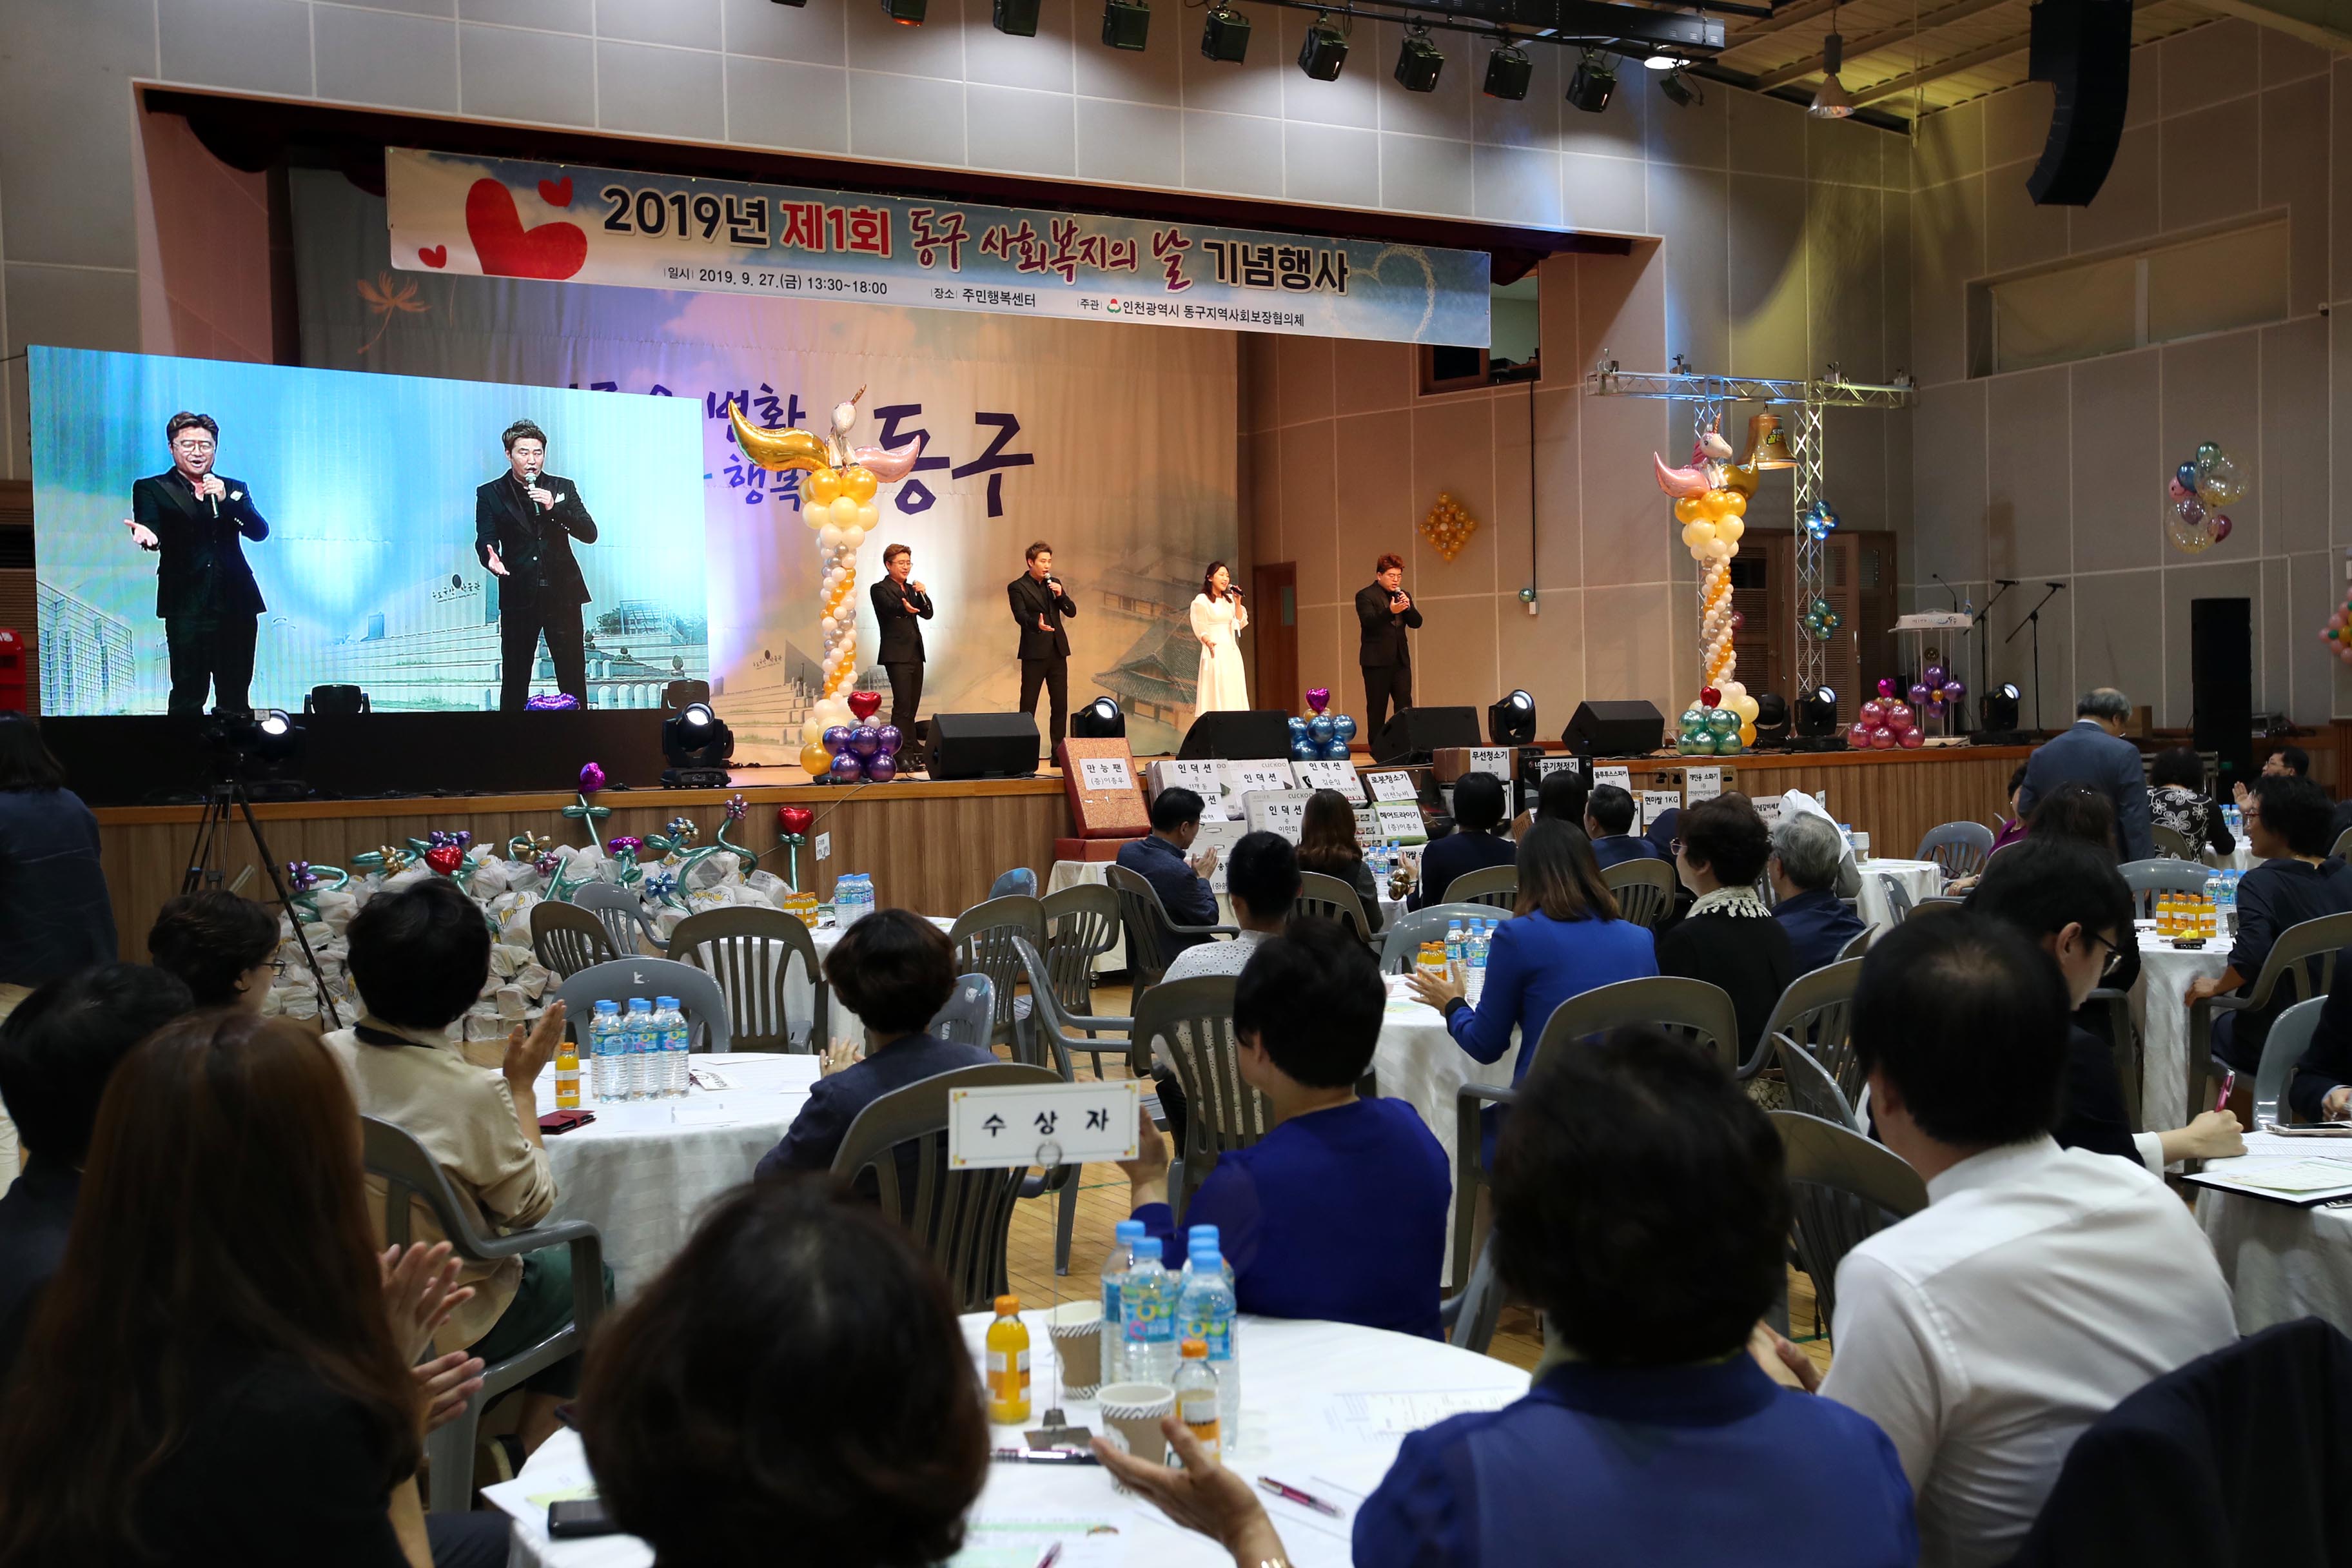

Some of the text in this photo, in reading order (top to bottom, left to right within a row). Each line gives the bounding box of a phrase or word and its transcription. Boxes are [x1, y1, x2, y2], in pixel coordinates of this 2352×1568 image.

[602, 186, 1348, 293] 2019년 제1회 동구 사회복지의 날 기념행사
[807, 277, 888, 295] 13:30~18:00
[962, 288, 1036, 308] 주민행복센터
[1122, 300, 1179, 317] 인천광역시
[1183, 304, 1305, 327] 동구지역사회보장협의체
[873, 403, 1035, 518] 동구
[1471, 750, 1508, 761] 무선청소기
[1542, 761, 1578, 772] 공기청정기
[1371, 773, 1408, 784] 로봇청소기
[1645, 796, 1663, 805] 현미쌀
[1379, 811, 1420, 819] 헤어드라이기
